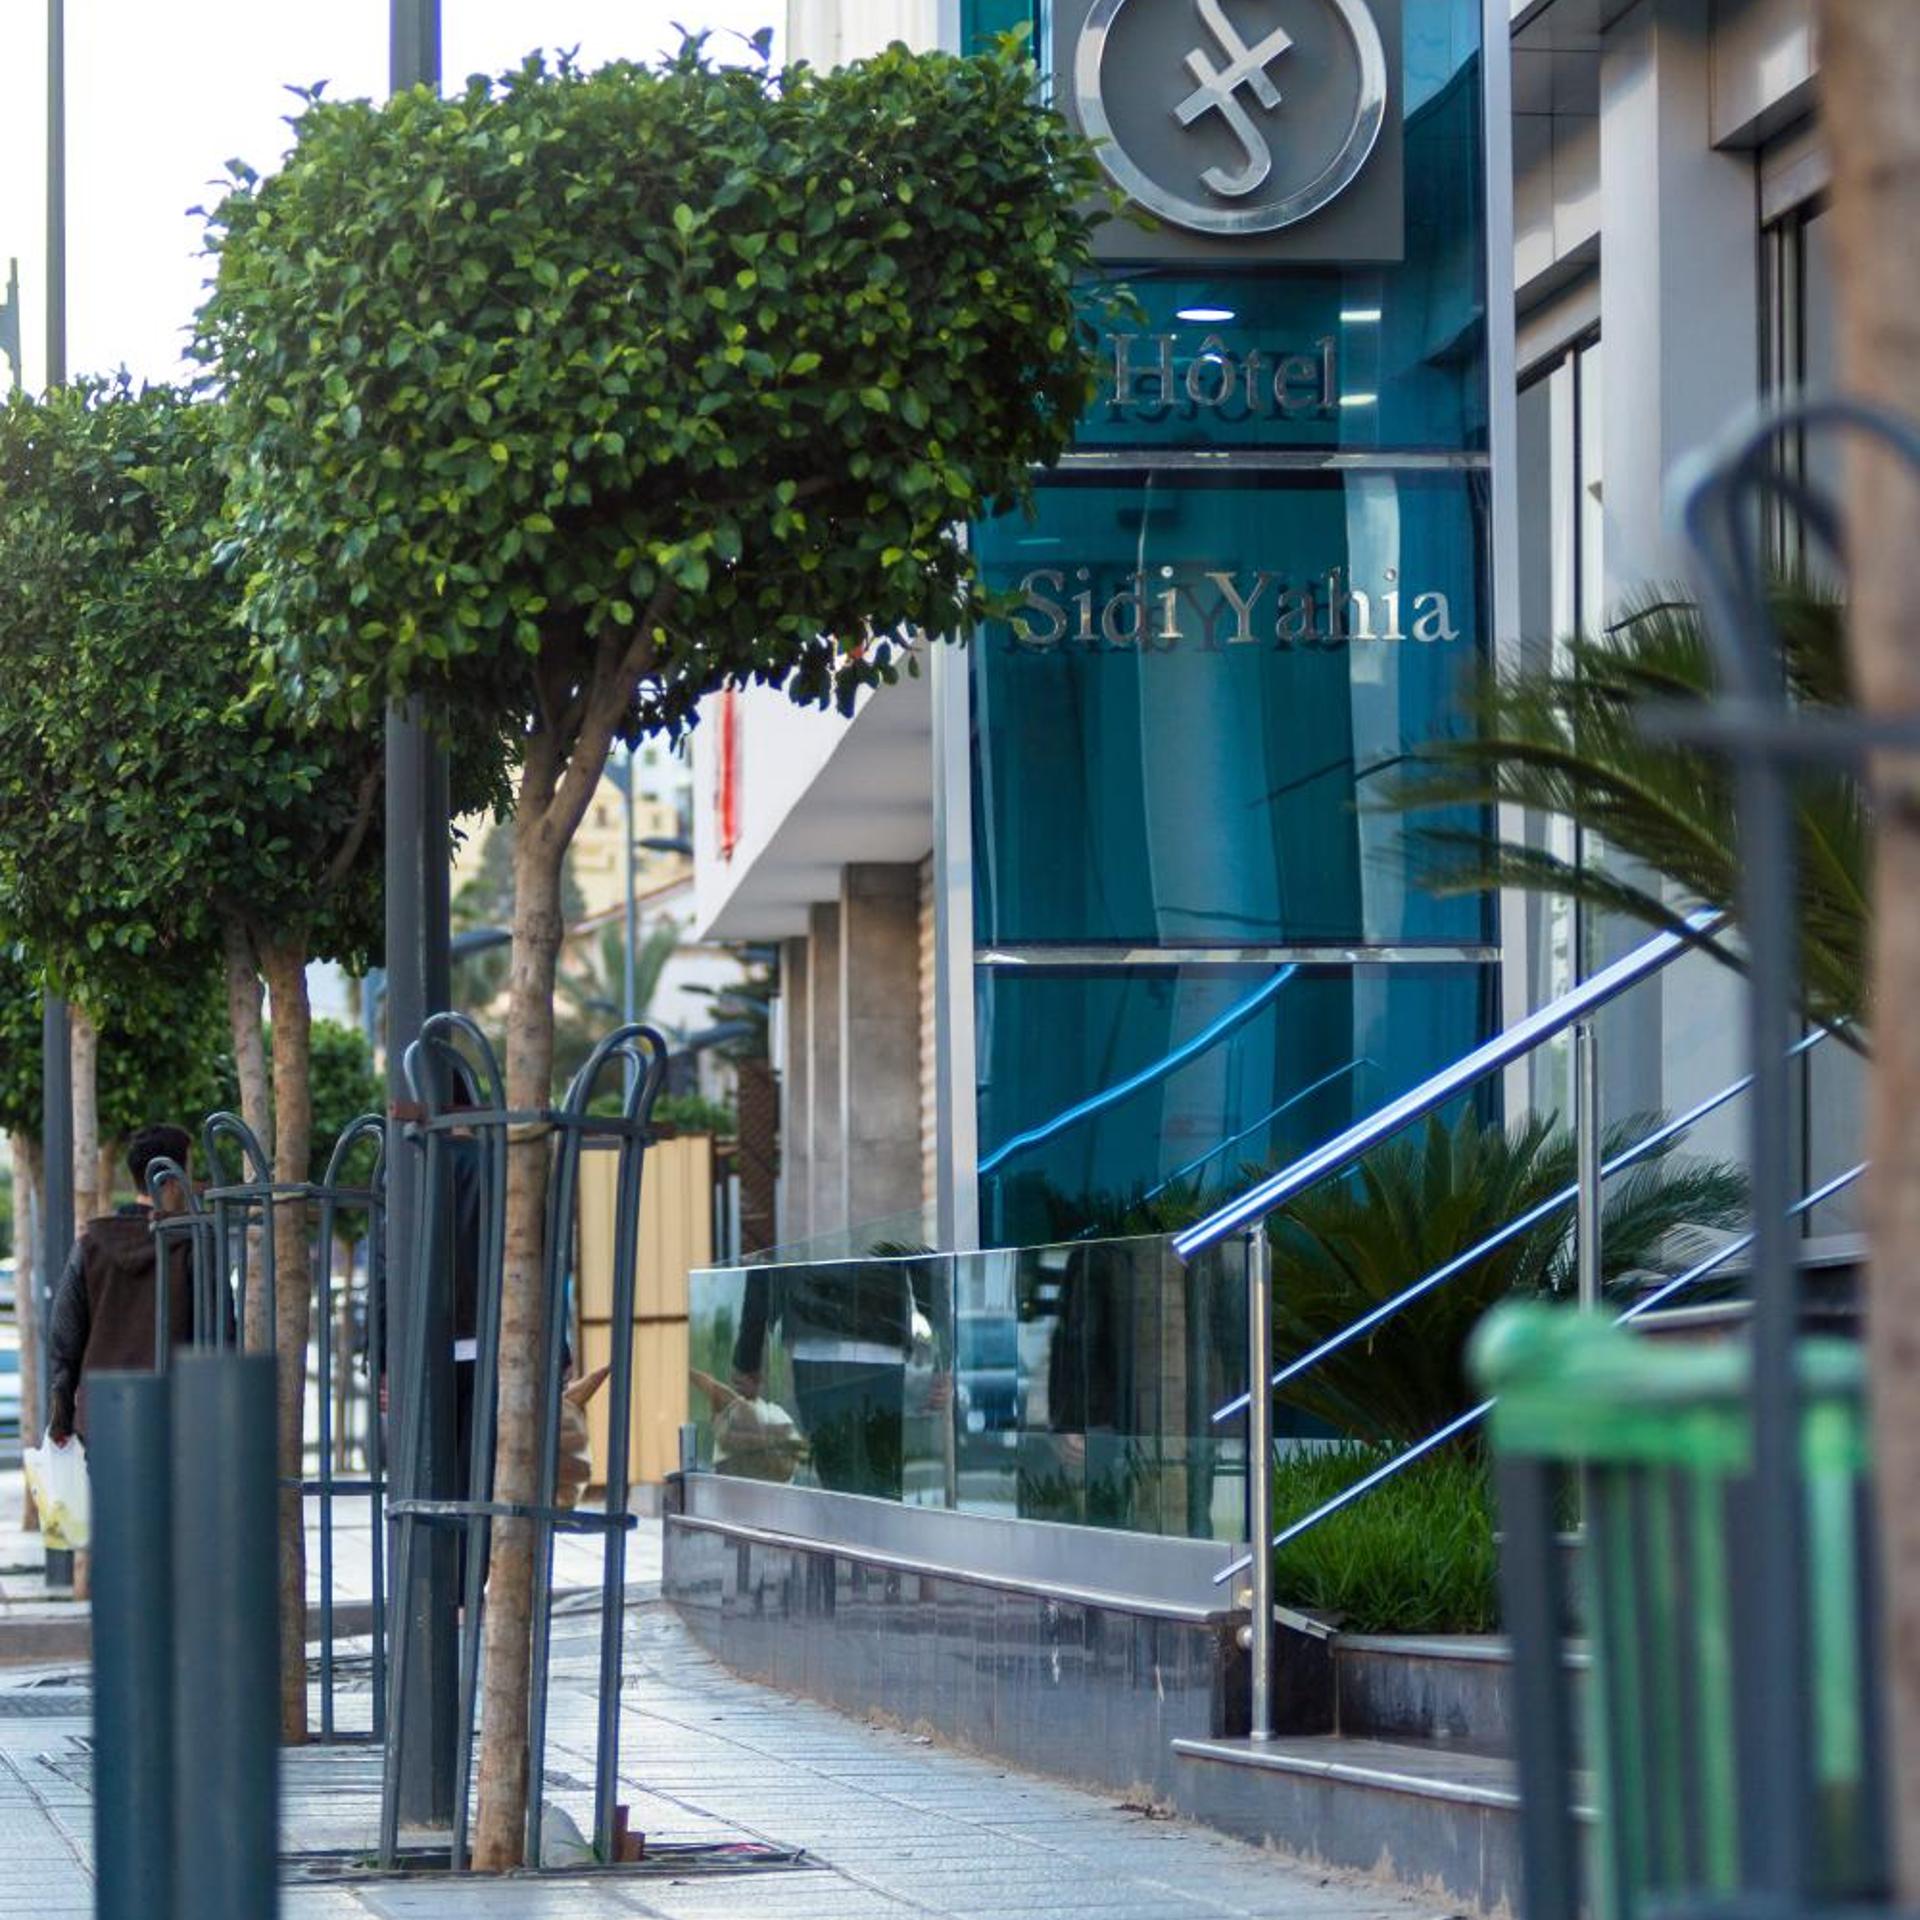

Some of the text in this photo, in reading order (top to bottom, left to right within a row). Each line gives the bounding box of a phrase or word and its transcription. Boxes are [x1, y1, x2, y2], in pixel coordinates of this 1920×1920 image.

[1104, 333, 1340, 409] Hôtel
[1019, 567, 1459, 646] Sidi Yahia
